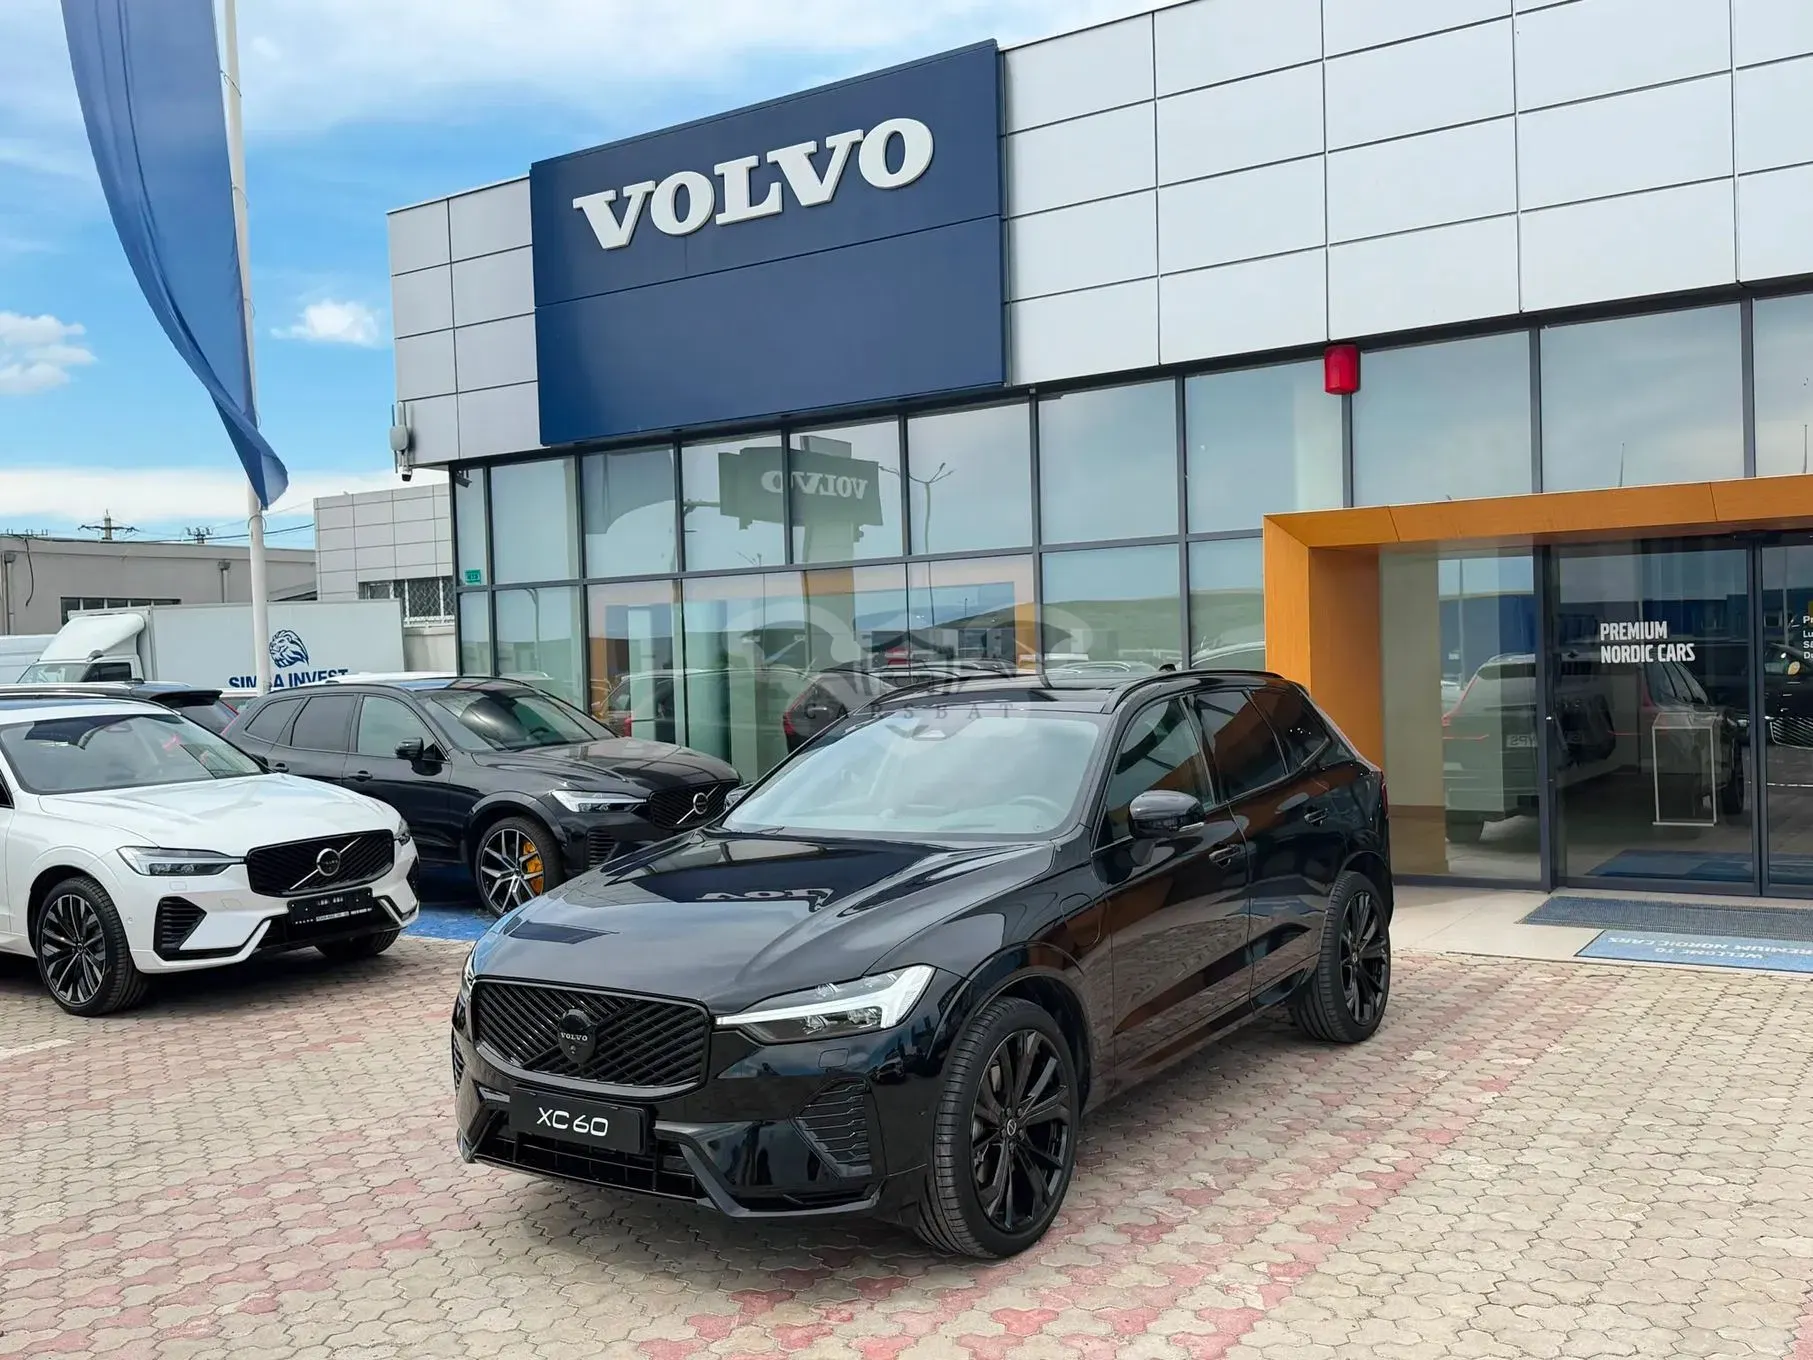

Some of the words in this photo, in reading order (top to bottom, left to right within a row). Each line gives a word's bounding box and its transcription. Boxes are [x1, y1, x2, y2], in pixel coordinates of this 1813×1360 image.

[572, 117, 934, 250] VOLVO
[1600, 621, 1668, 641] PREMIUM
[1600, 644, 1654, 664] NORDIC
[1657, 643, 1696, 662] CARS
[228, 674, 285, 688] SIMA
[1733, 943, 1813, 956] REMIUM
[560, 1032, 588, 1042] VOLVO
